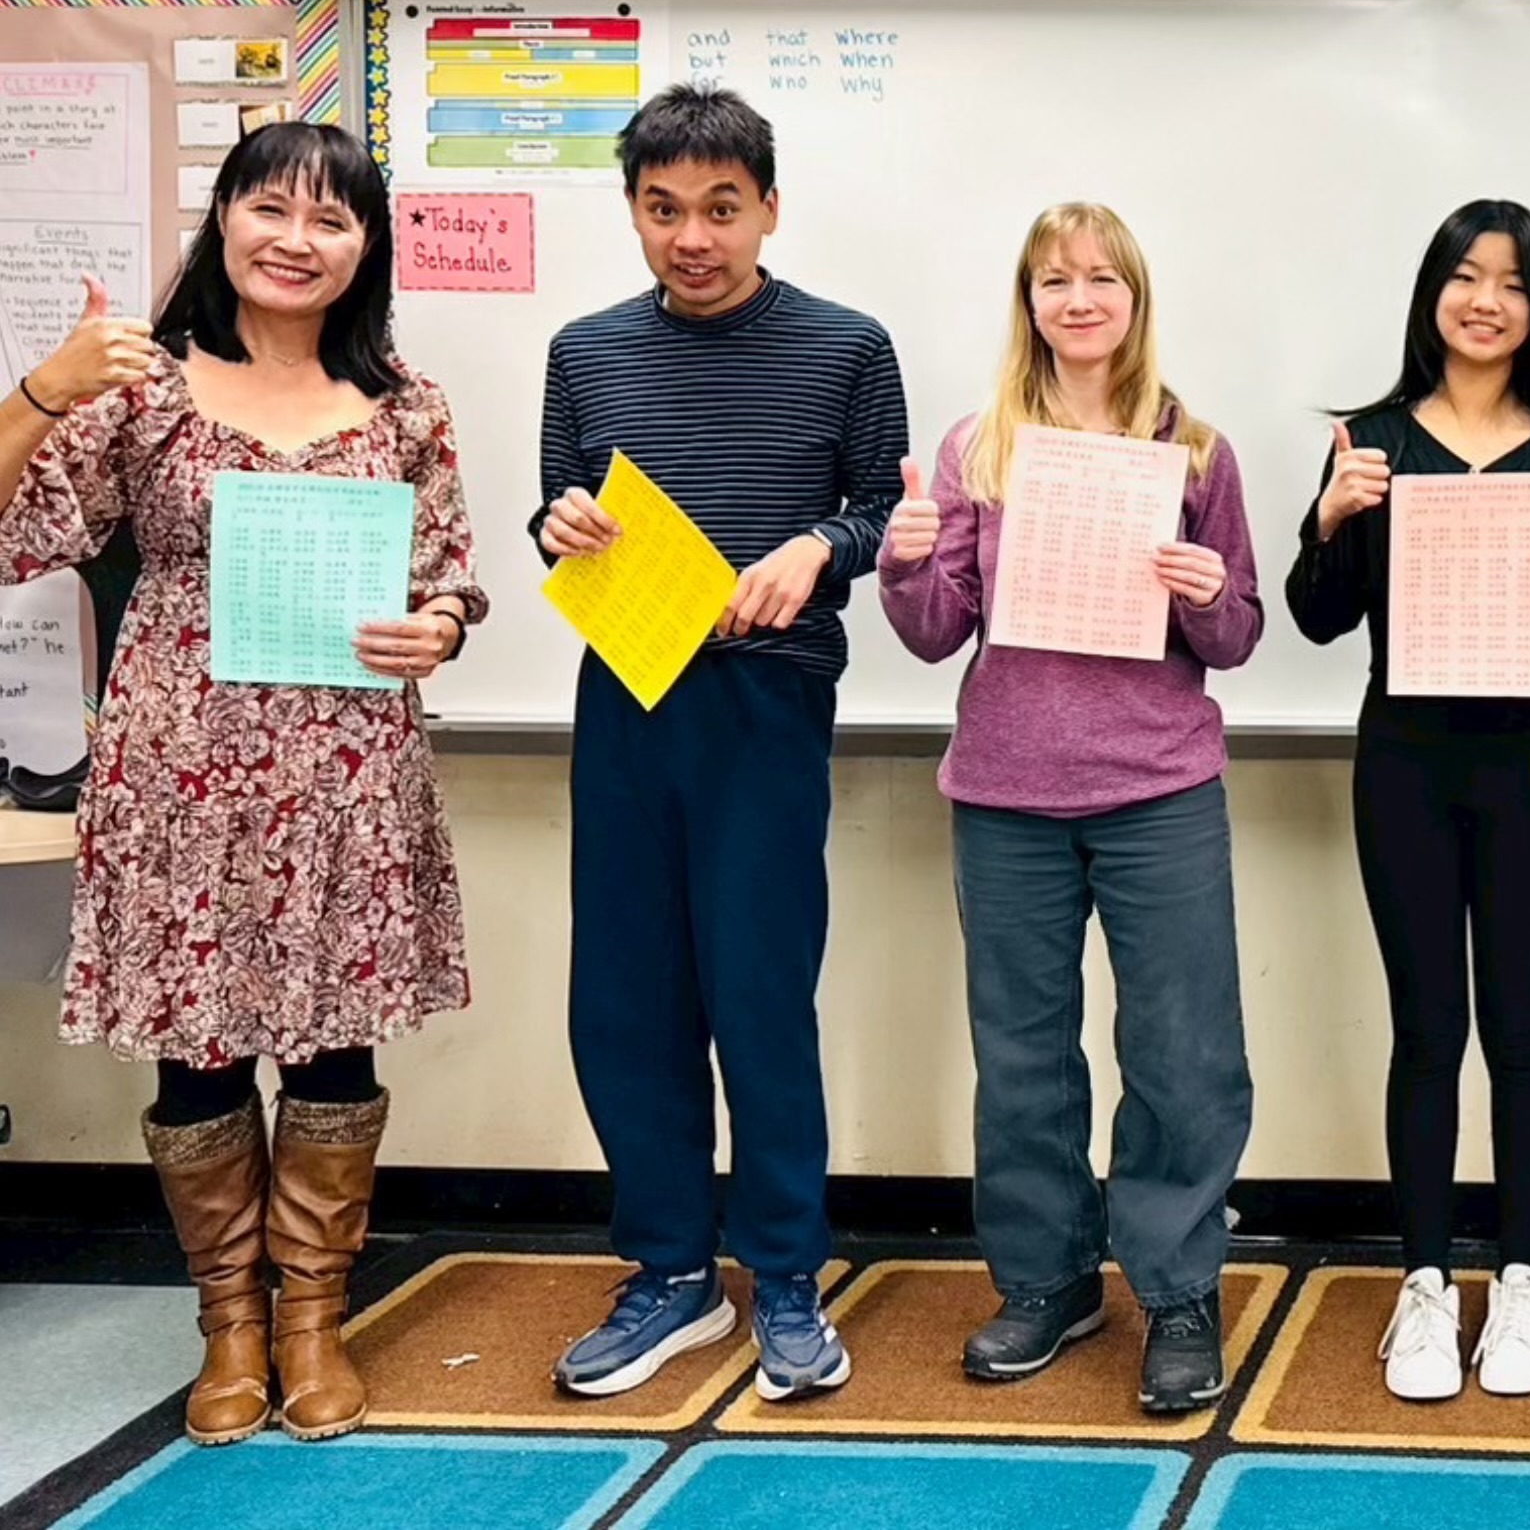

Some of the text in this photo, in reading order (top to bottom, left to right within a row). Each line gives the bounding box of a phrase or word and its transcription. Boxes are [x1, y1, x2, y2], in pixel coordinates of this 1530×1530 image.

[687, 28, 731, 47] and
[765, 27, 808, 45] that
[689, 52, 727, 70] but
[413, 241, 512, 274] Schedule
[32, 620, 60, 632] can
